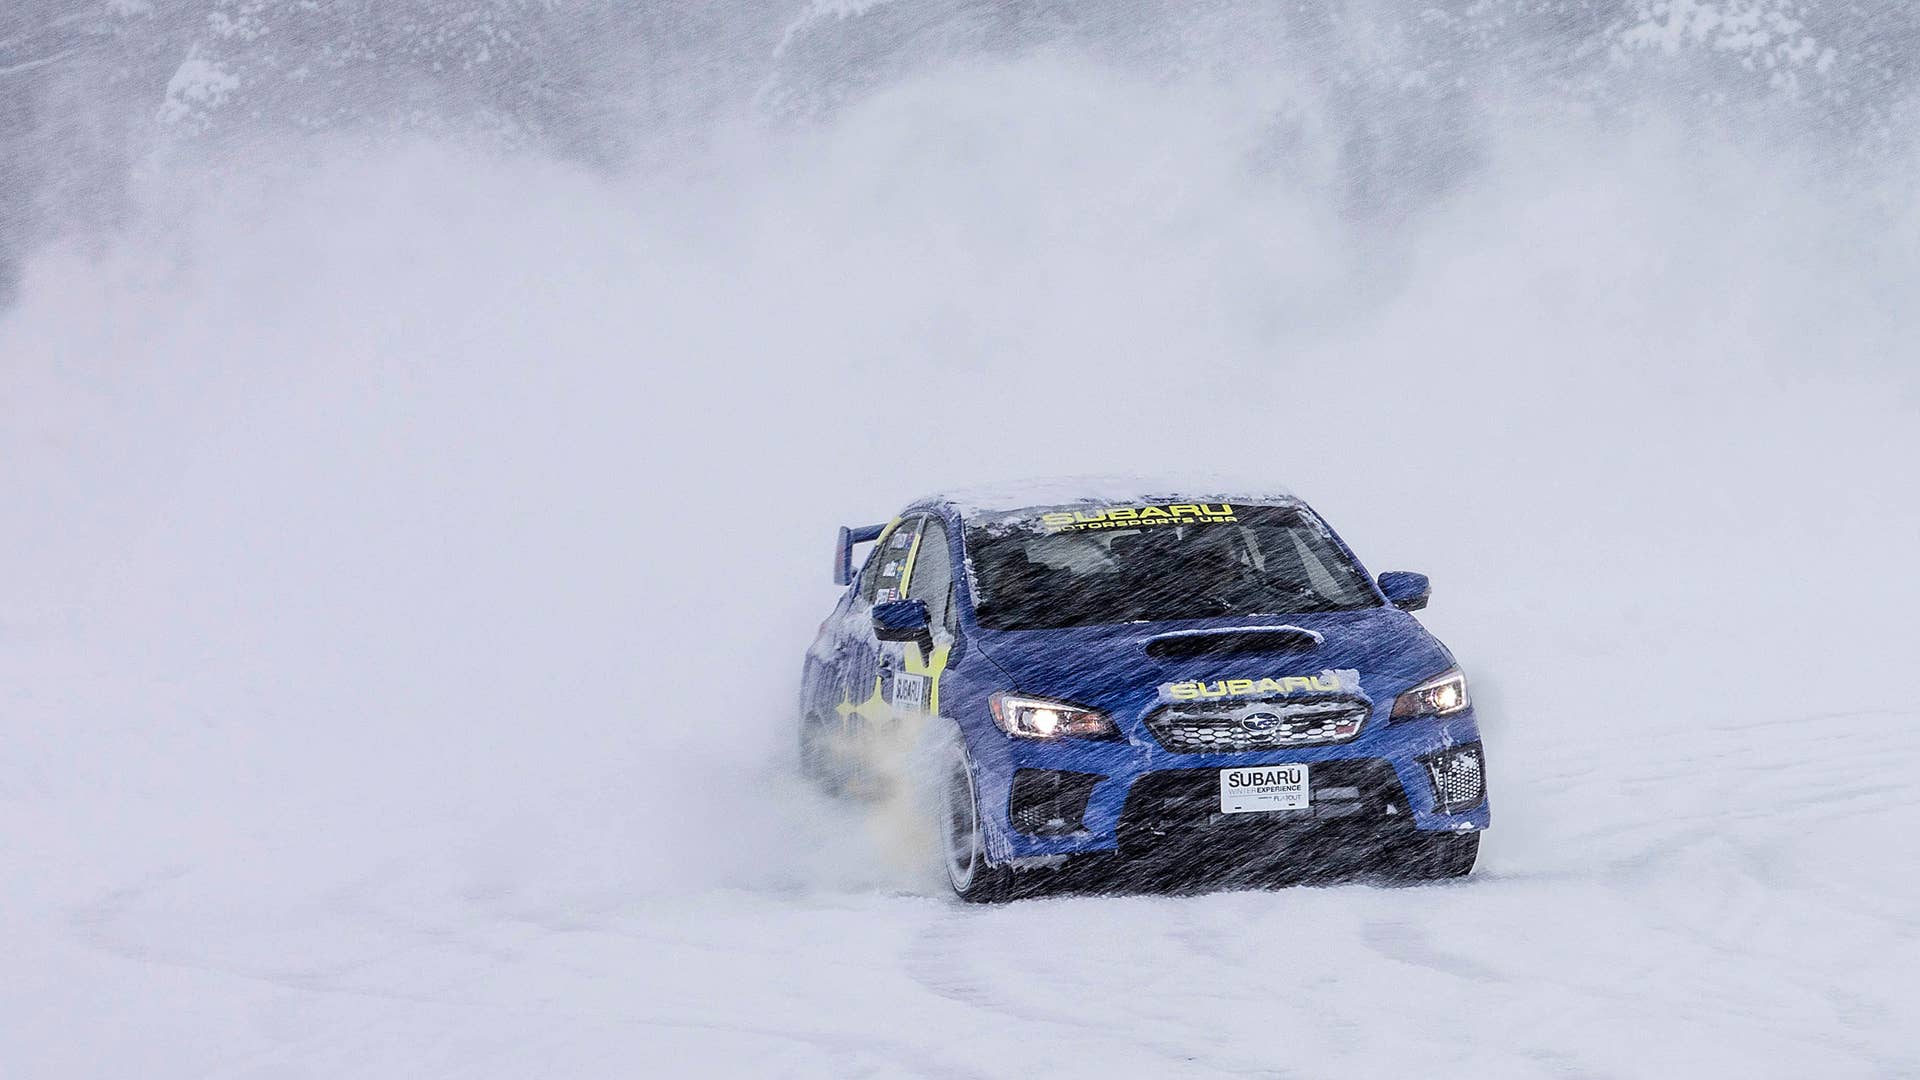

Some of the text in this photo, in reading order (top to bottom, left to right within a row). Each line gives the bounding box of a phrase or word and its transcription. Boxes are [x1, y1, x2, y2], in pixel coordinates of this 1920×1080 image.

[1042, 503, 1233, 525] SUBARU
[1200, 515, 1238, 523] USA
[896, 679, 920, 702] SUBARU
[1170, 675, 1340, 700] SUBARU
[1229, 769, 1301, 788] SUBARU
